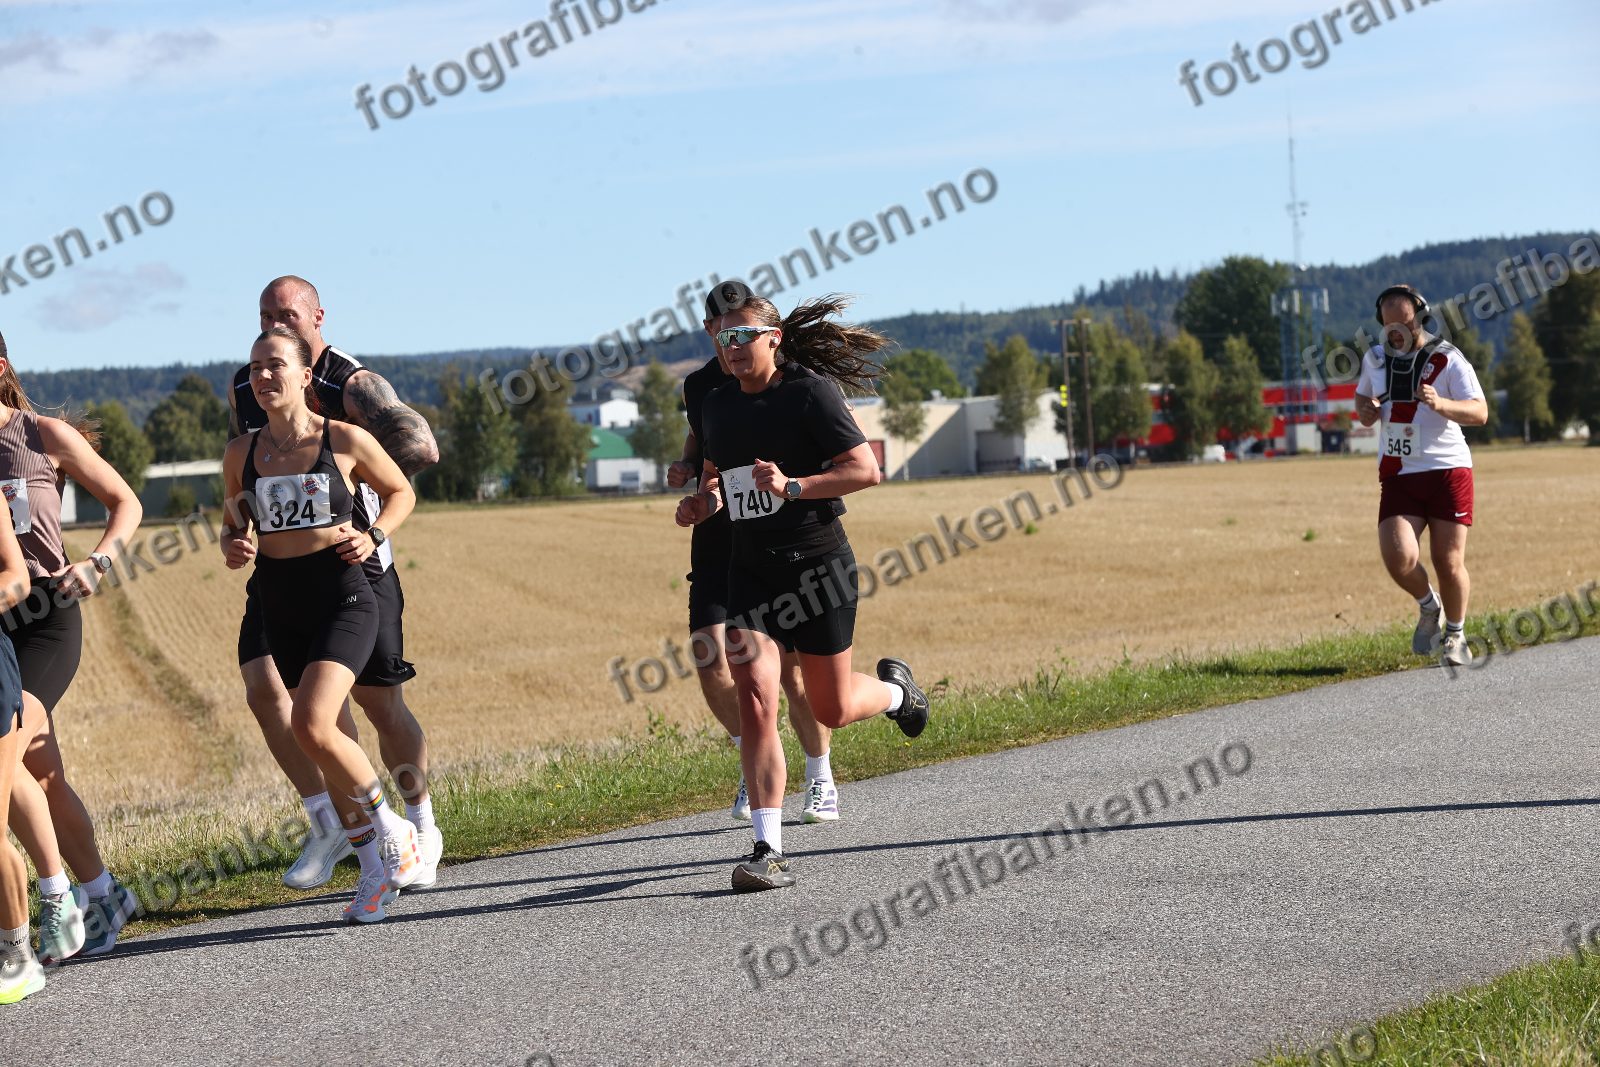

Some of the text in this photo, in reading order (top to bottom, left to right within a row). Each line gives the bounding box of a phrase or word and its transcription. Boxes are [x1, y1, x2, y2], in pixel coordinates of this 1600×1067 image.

[1387, 438, 1412, 456] 545
[269, 499, 317, 529] 324
[733, 489, 773, 517] 740
